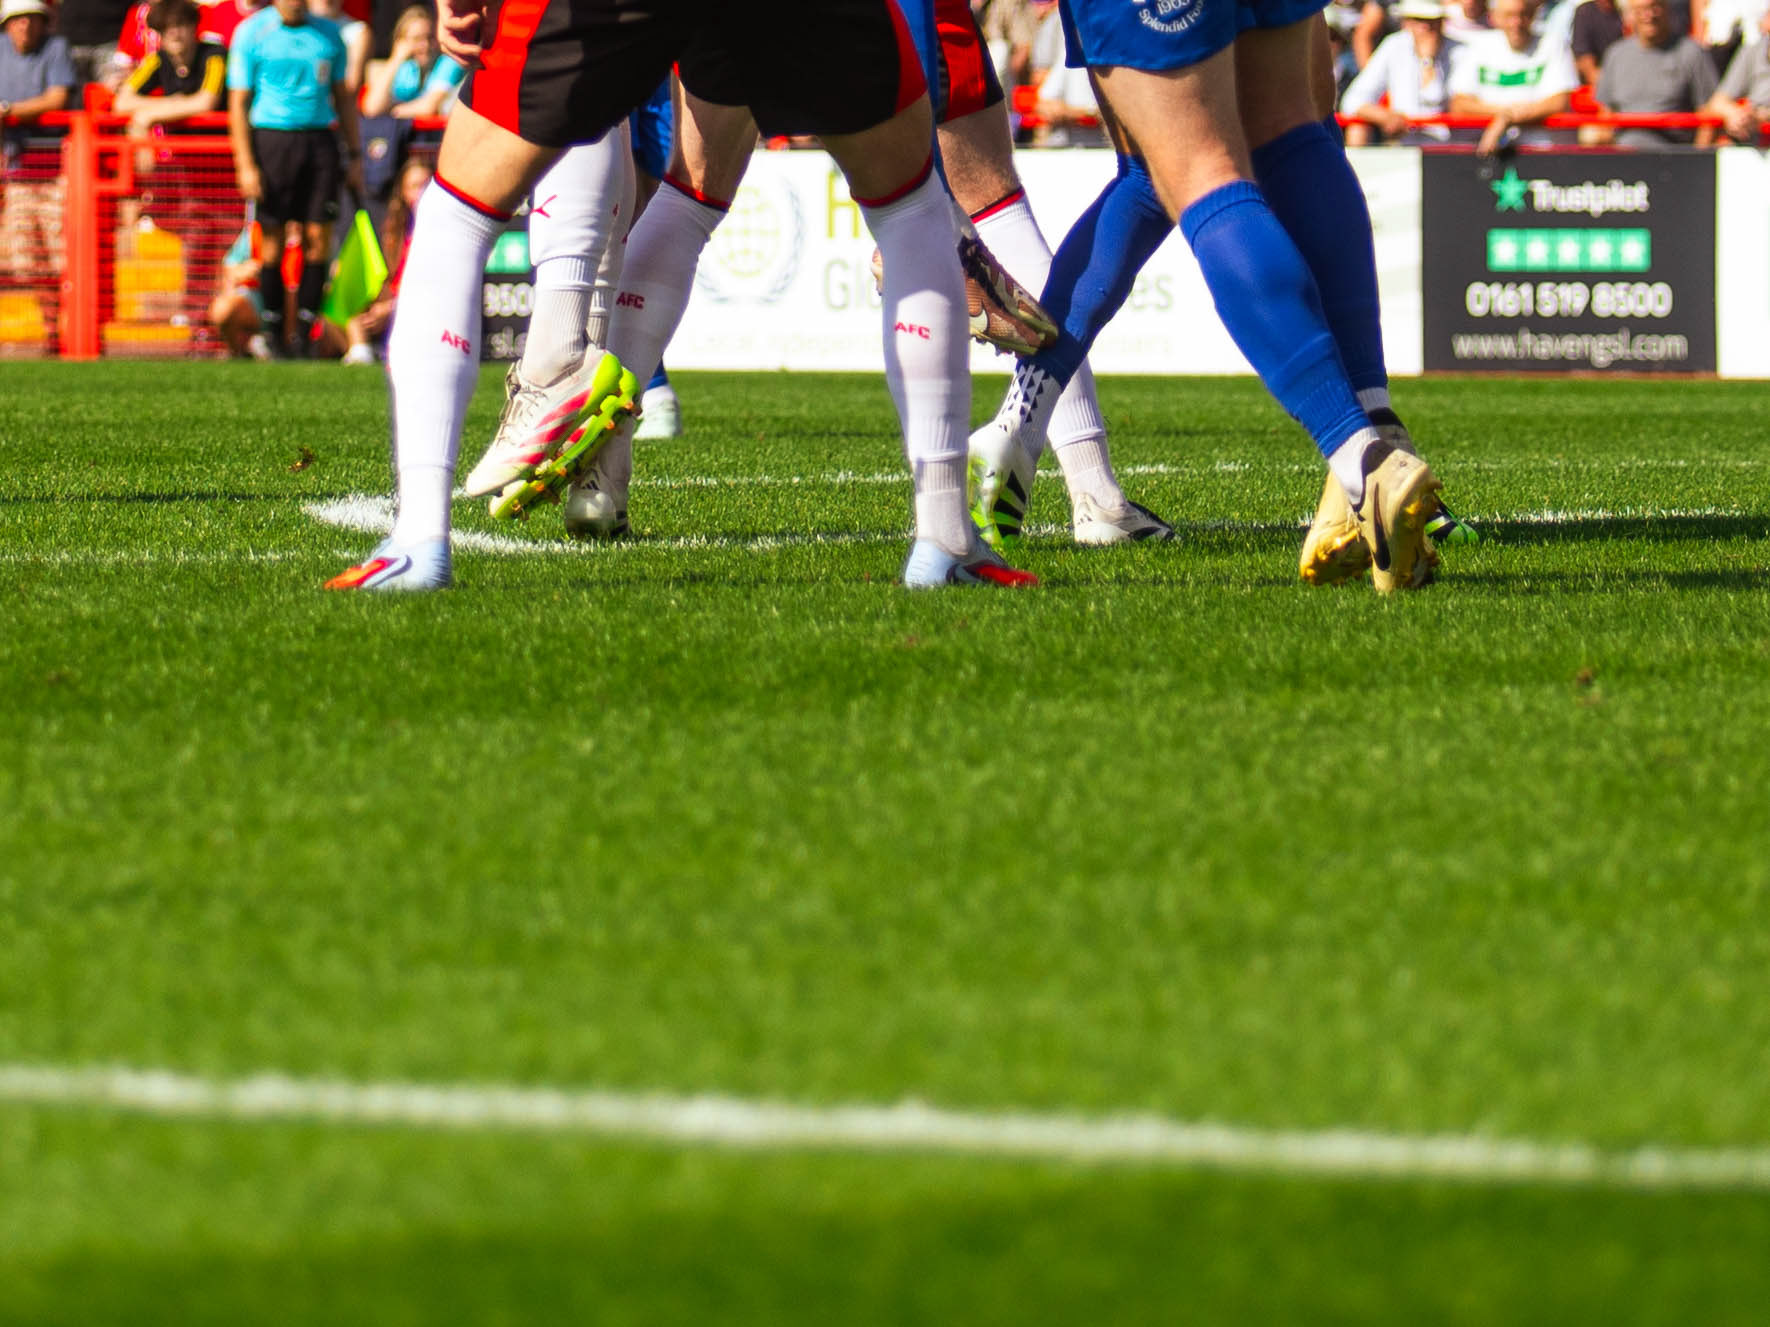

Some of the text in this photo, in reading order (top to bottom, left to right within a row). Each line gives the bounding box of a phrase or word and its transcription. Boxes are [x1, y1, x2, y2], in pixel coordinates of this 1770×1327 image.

[1139, 8, 1189, 33] Splendid
[1528, 179, 1650, 218] Trustpilot
[615, 291, 645, 310] AFC
[1466, 281, 1673, 318] 0161 519 8500
[441, 329, 471, 355] AFC
[893, 321, 930, 340] AFC
[1451, 326, 1689, 369] www.havengsl.com
